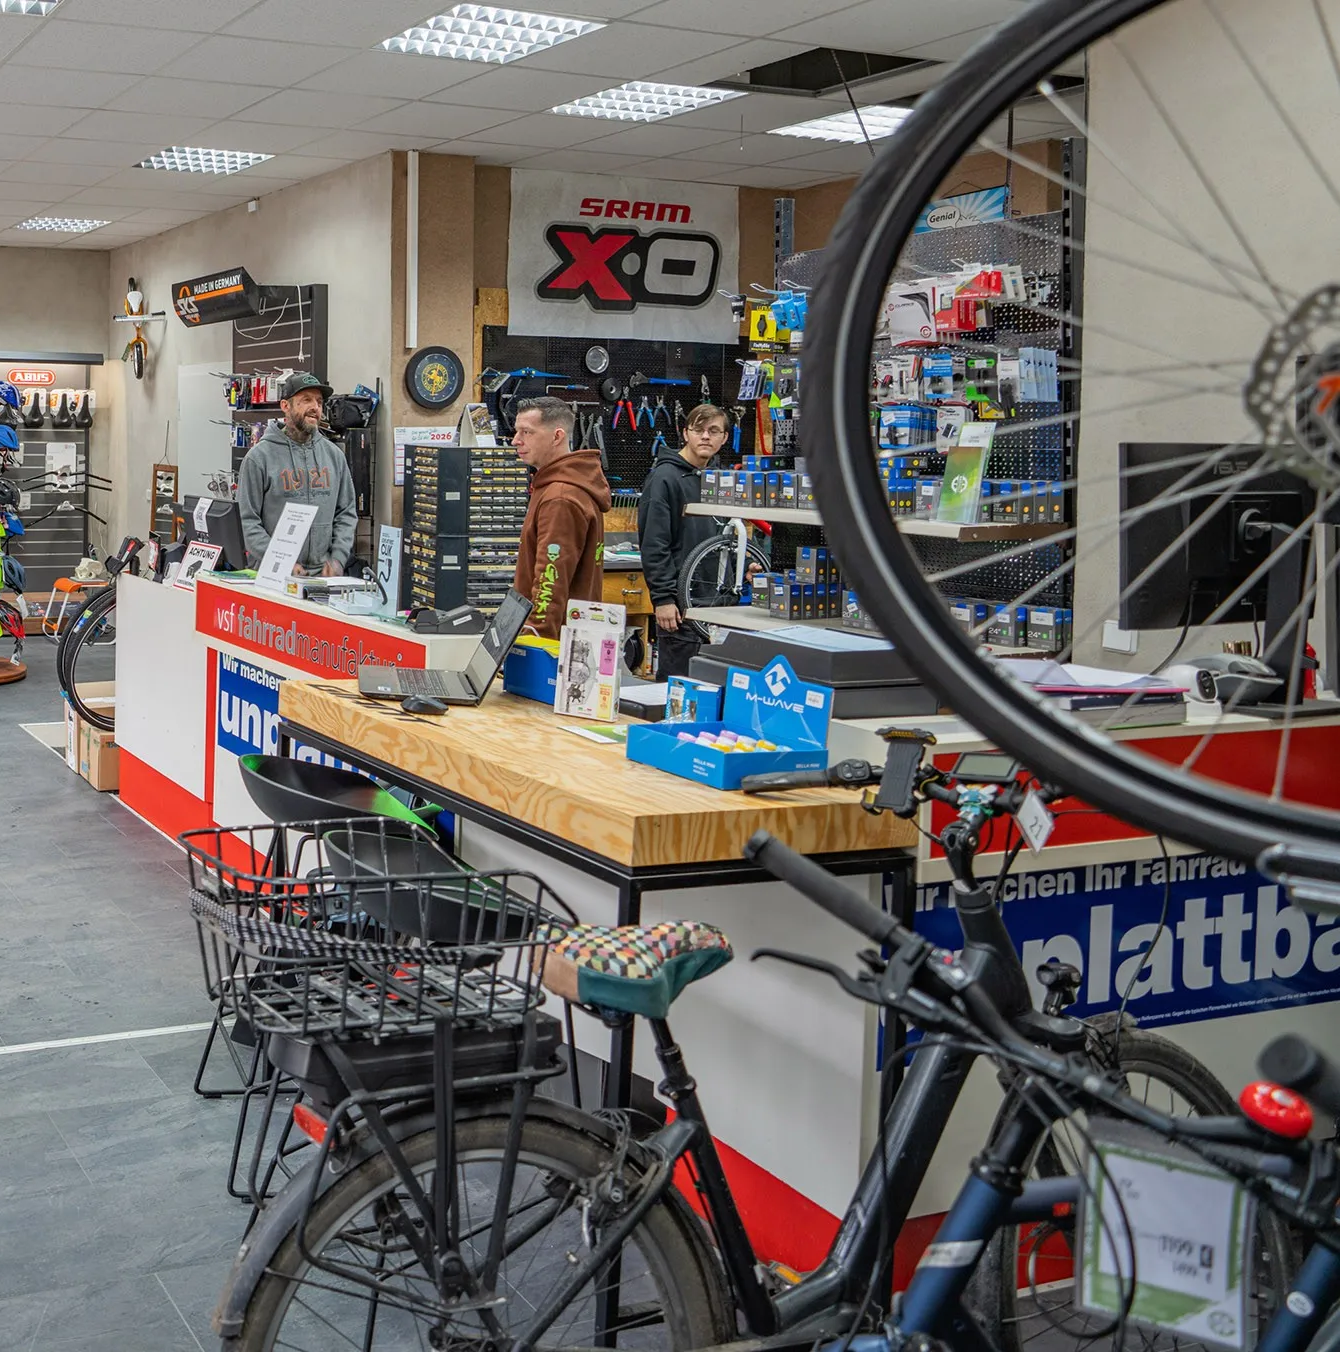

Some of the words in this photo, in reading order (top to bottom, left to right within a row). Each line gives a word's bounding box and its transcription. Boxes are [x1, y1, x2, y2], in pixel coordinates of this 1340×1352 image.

[579, 198, 691, 223] SRAM
[929, 210, 956, 223] Genial
[193, 283, 208, 295] MADE
[208, 280, 215, 291] IN
[214, 274, 241, 290] GERMANY
[15, 372, 49, 382] ABUS
[431, 432, 452, 440] 2026
[189, 547, 215, 560] ACHTUNG
[217, 603, 235, 633] vsf
[238, 605, 395, 676] fahrradmanufakt
[222, 652, 238, 674] Wir
[745, 691, 805, 714] M-WAVE
[1085, 862, 1127, 892] Ihr
